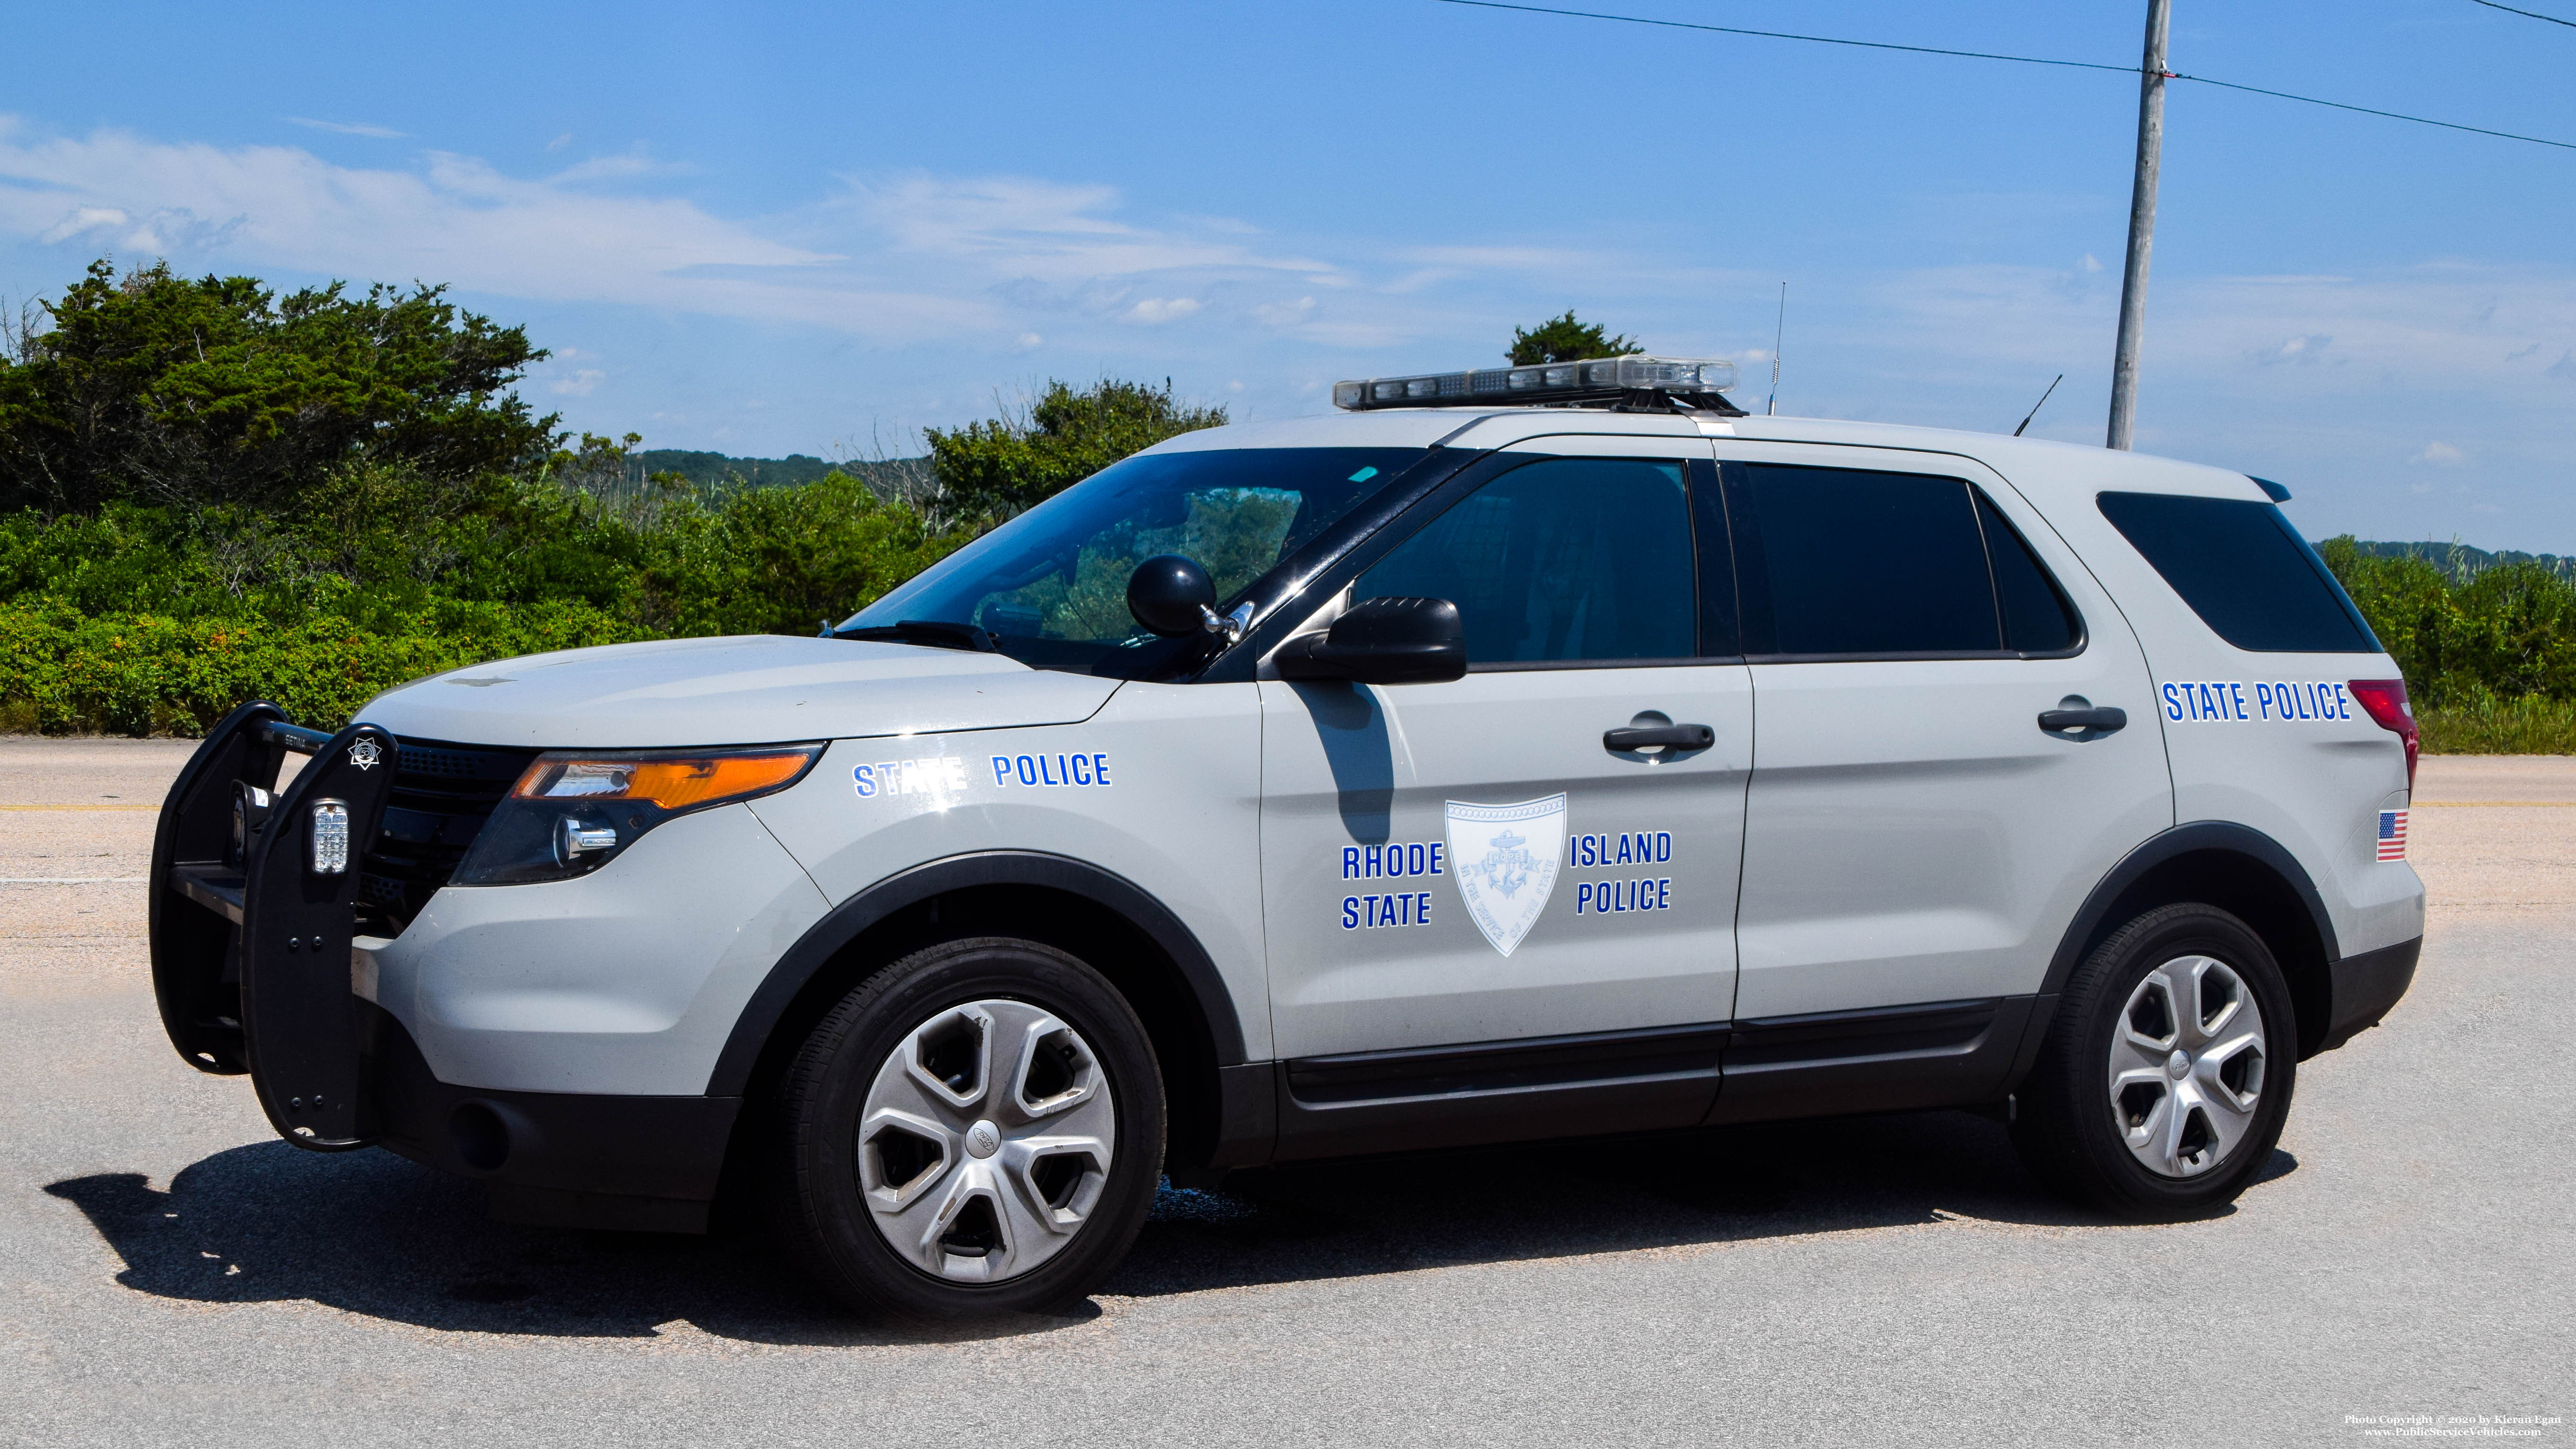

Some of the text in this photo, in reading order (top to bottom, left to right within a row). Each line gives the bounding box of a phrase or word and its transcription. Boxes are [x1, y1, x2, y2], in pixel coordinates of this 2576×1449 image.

[2161, 681, 2351, 722] STATE POLICE
[286, 735, 305, 749] SETINA
[852, 752, 1112, 798] STATE POLICE
[1342, 831, 1672, 880] RHODE ISLAND
[1493, 852, 1521, 861] HOPE
[1341, 877, 1671, 931] STATE POLICE
[1460, 859, 1554, 940] IN THE SERVICE OF THE STATE
[976, 1131, 993, 1148] Ford
